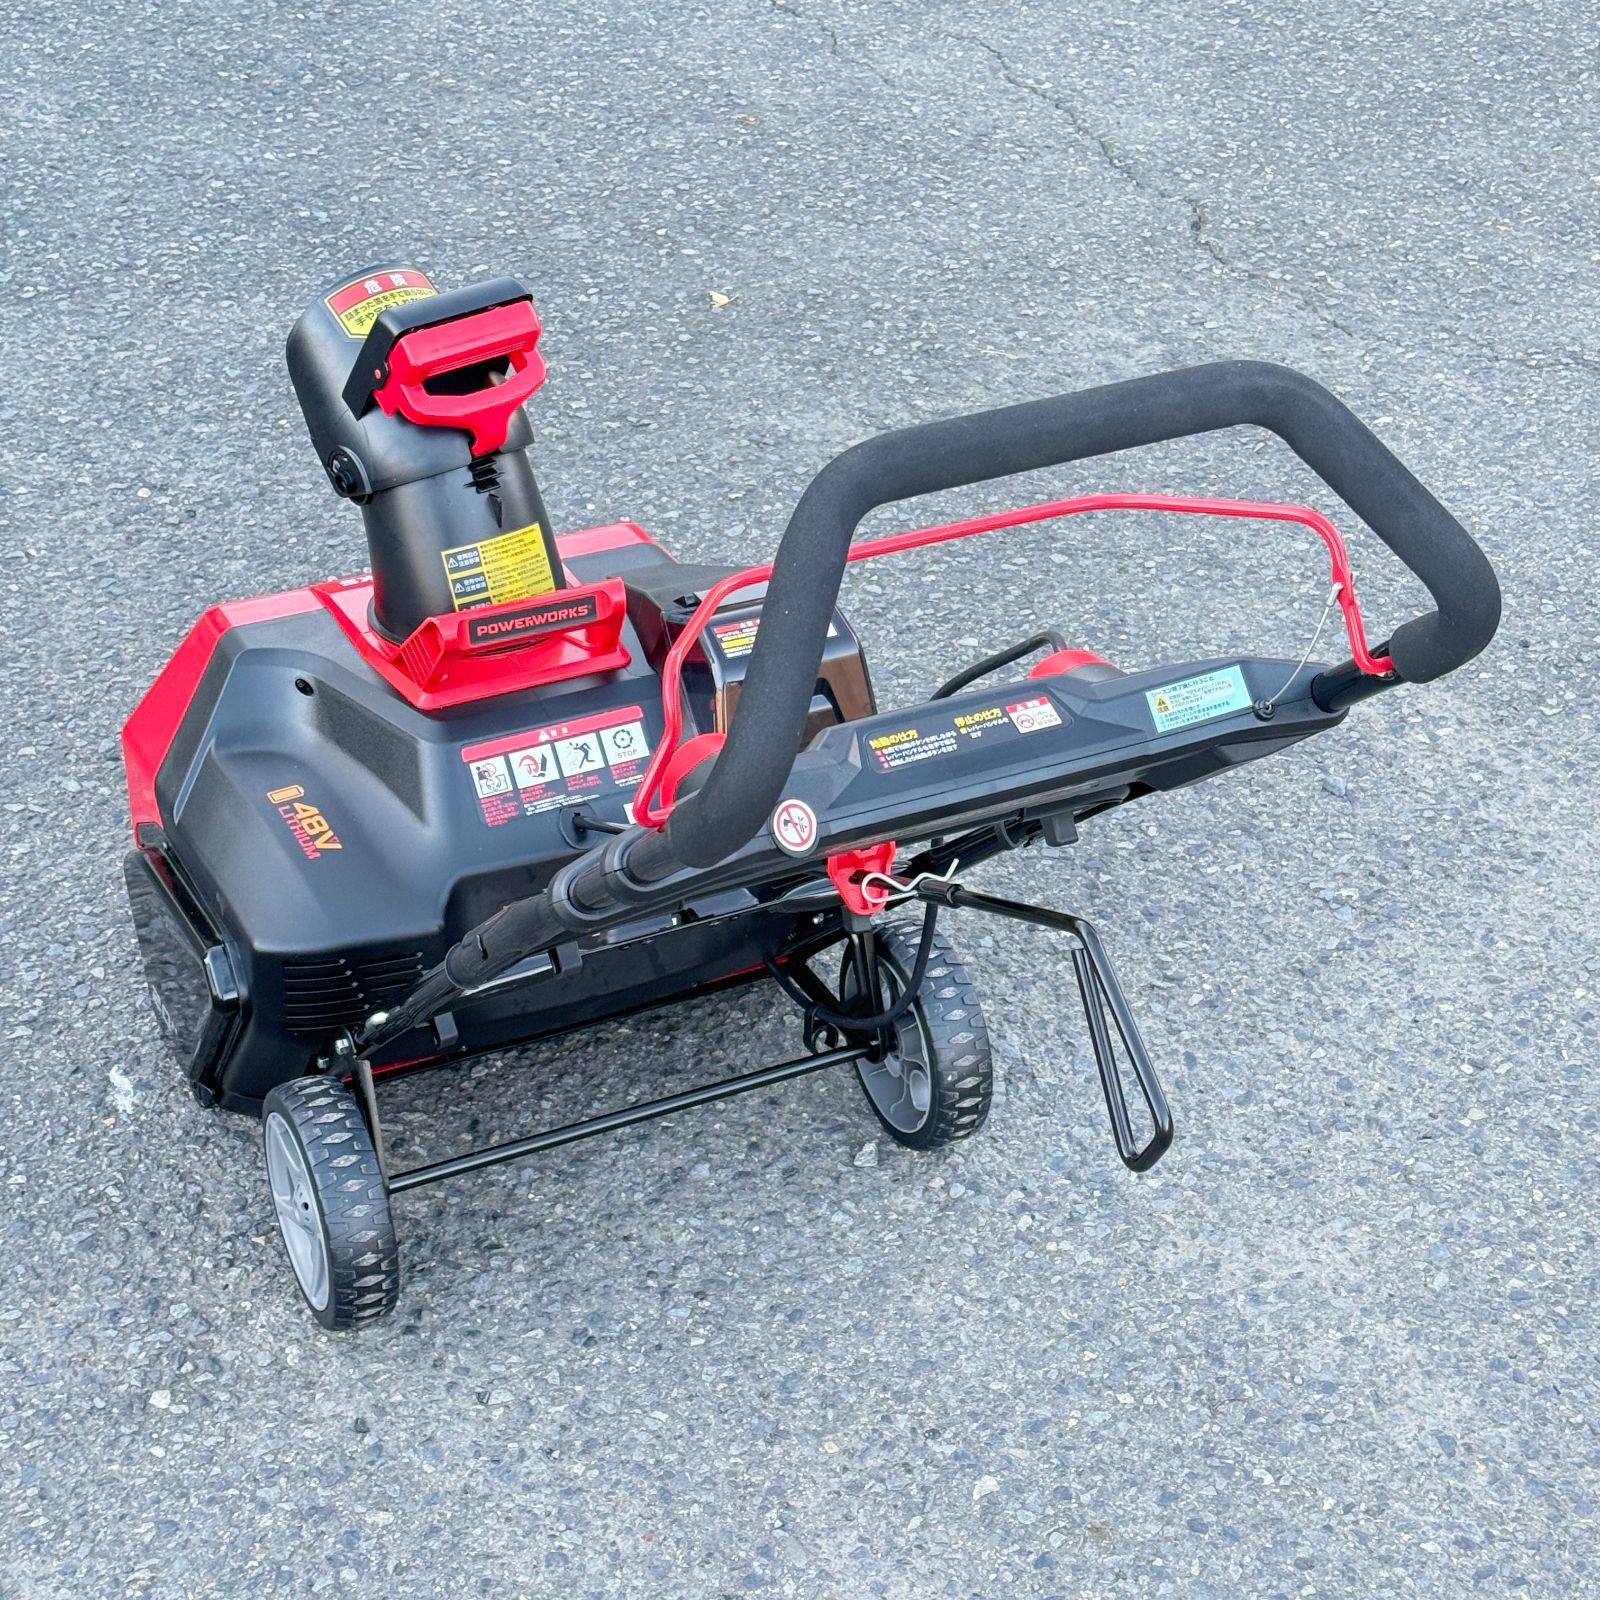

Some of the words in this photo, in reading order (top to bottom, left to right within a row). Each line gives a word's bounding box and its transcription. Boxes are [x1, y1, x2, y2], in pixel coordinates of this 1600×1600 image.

[363, 273, 408, 295] 危険
[476, 605, 589, 637] POWERWORKS
[954, 707, 1003, 728] 停止の仕方
[617, 749, 638, 759] STOP
[278, 805, 321, 859] LITHIUM
[293, 802, 343, 849] 48V
